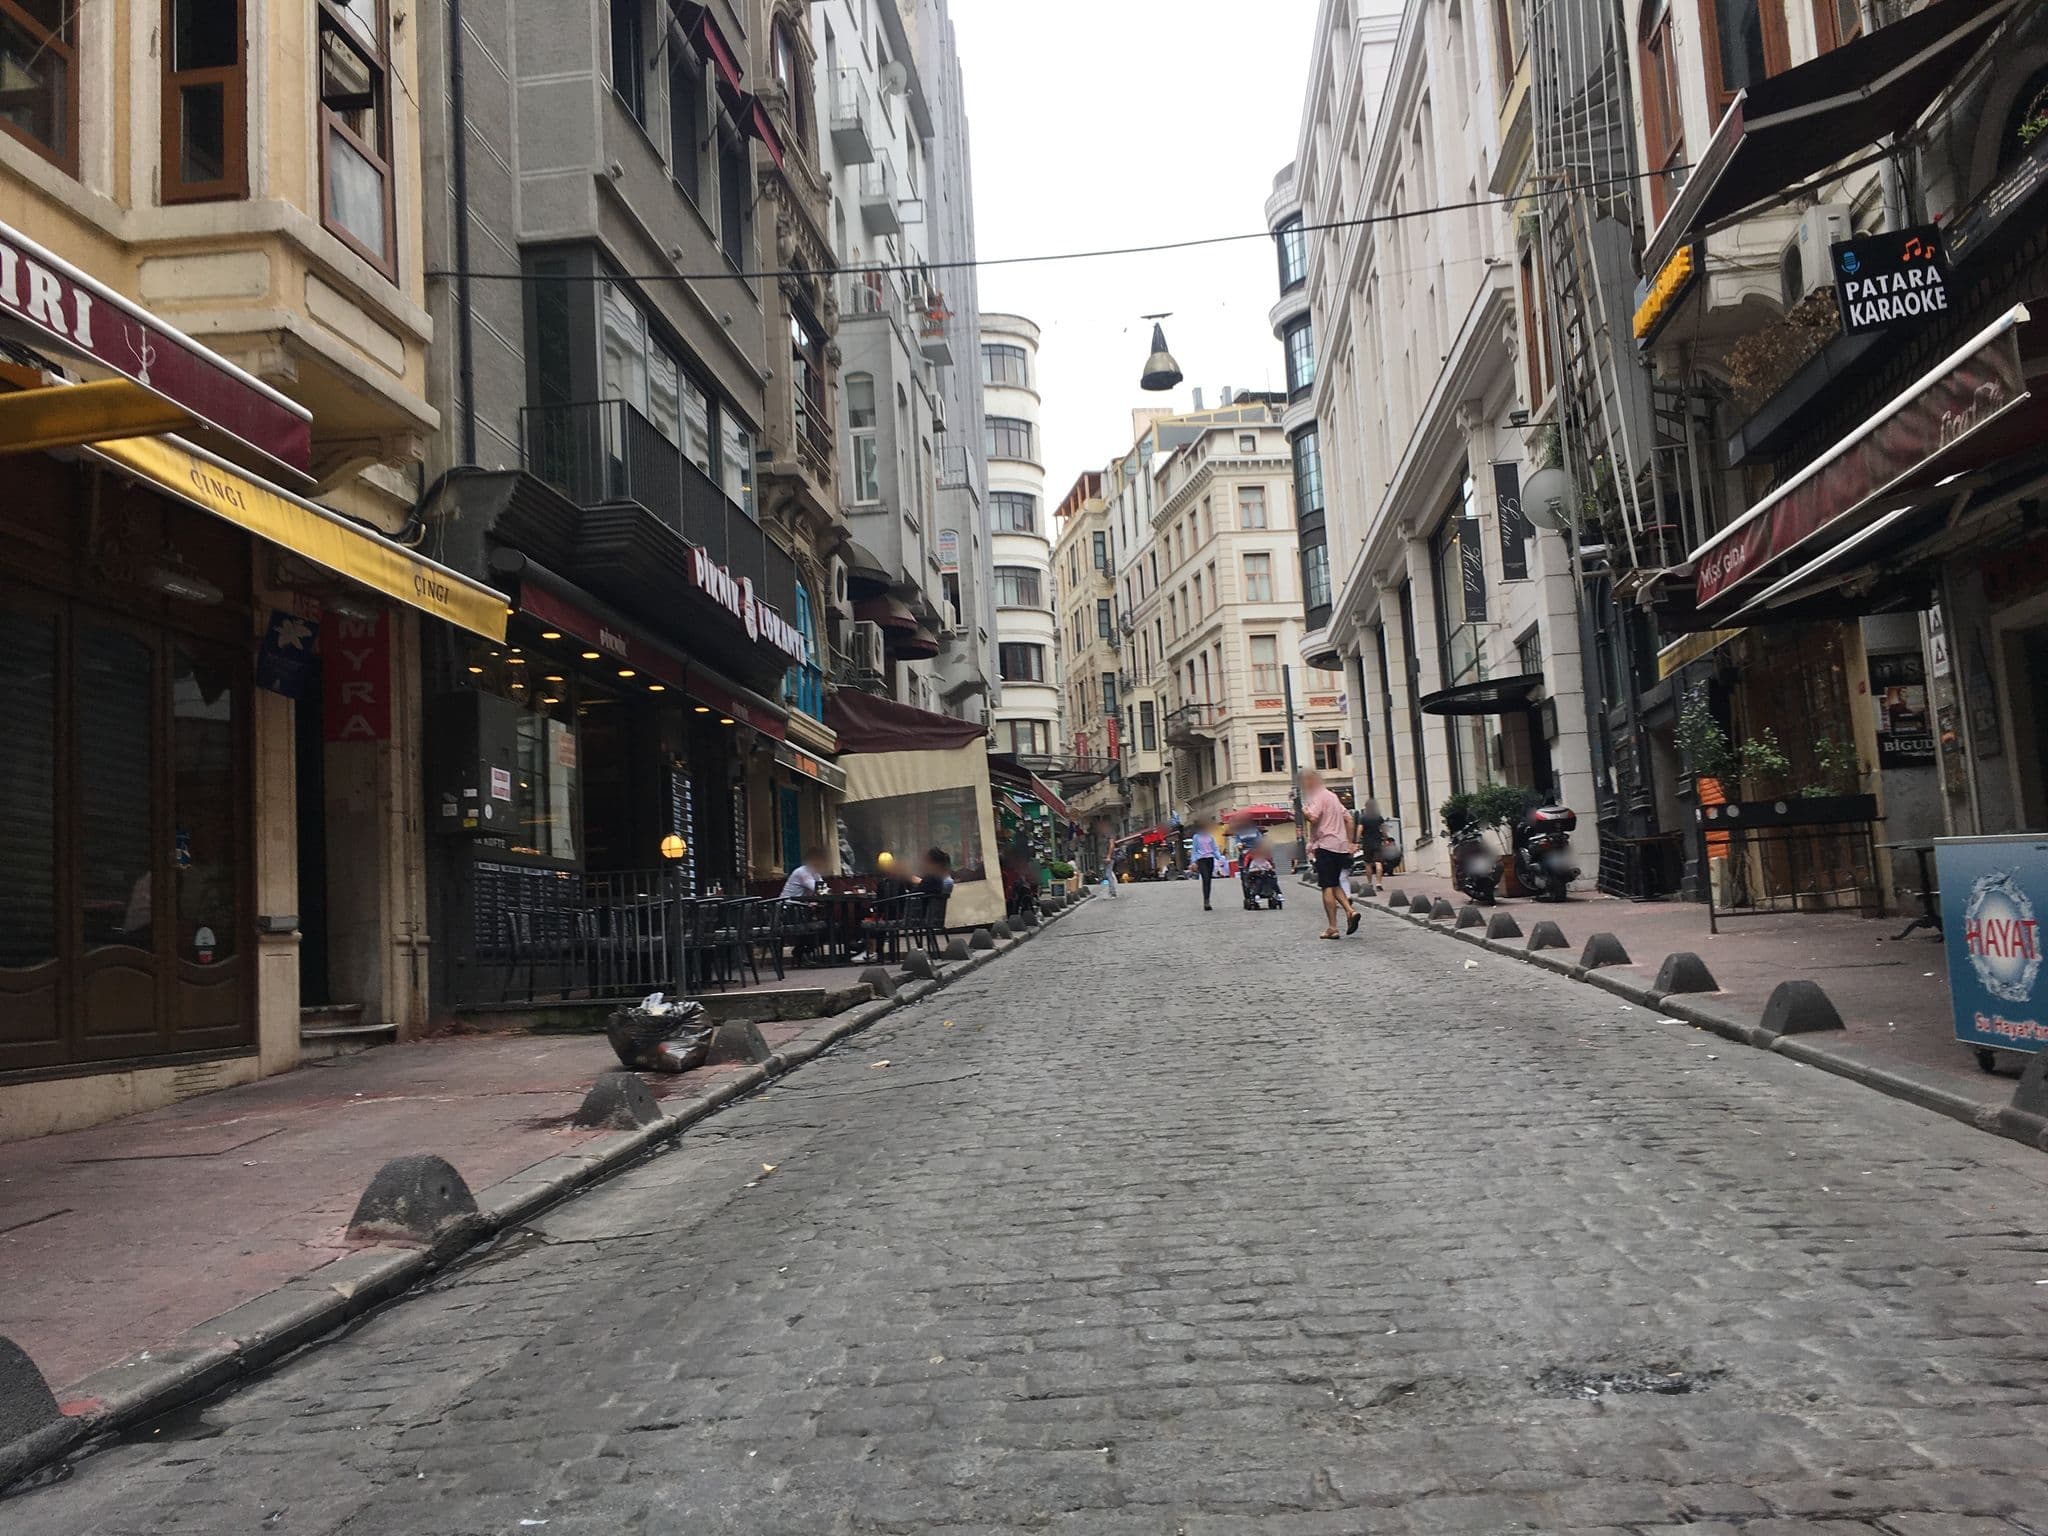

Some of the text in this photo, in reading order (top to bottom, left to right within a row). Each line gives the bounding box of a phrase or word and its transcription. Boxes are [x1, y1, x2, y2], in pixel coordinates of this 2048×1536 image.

[1845, 265, 1942, 301] PATARA
[1850, 286, 1948, 327] KARAOKE
[190, 469, 246, 510] ÇINGI
[414, 574, 449, 605] ÇINGI
[339, 616, 377, 738] MYRA
[1966, 918, 2037, 960] HAYAT
